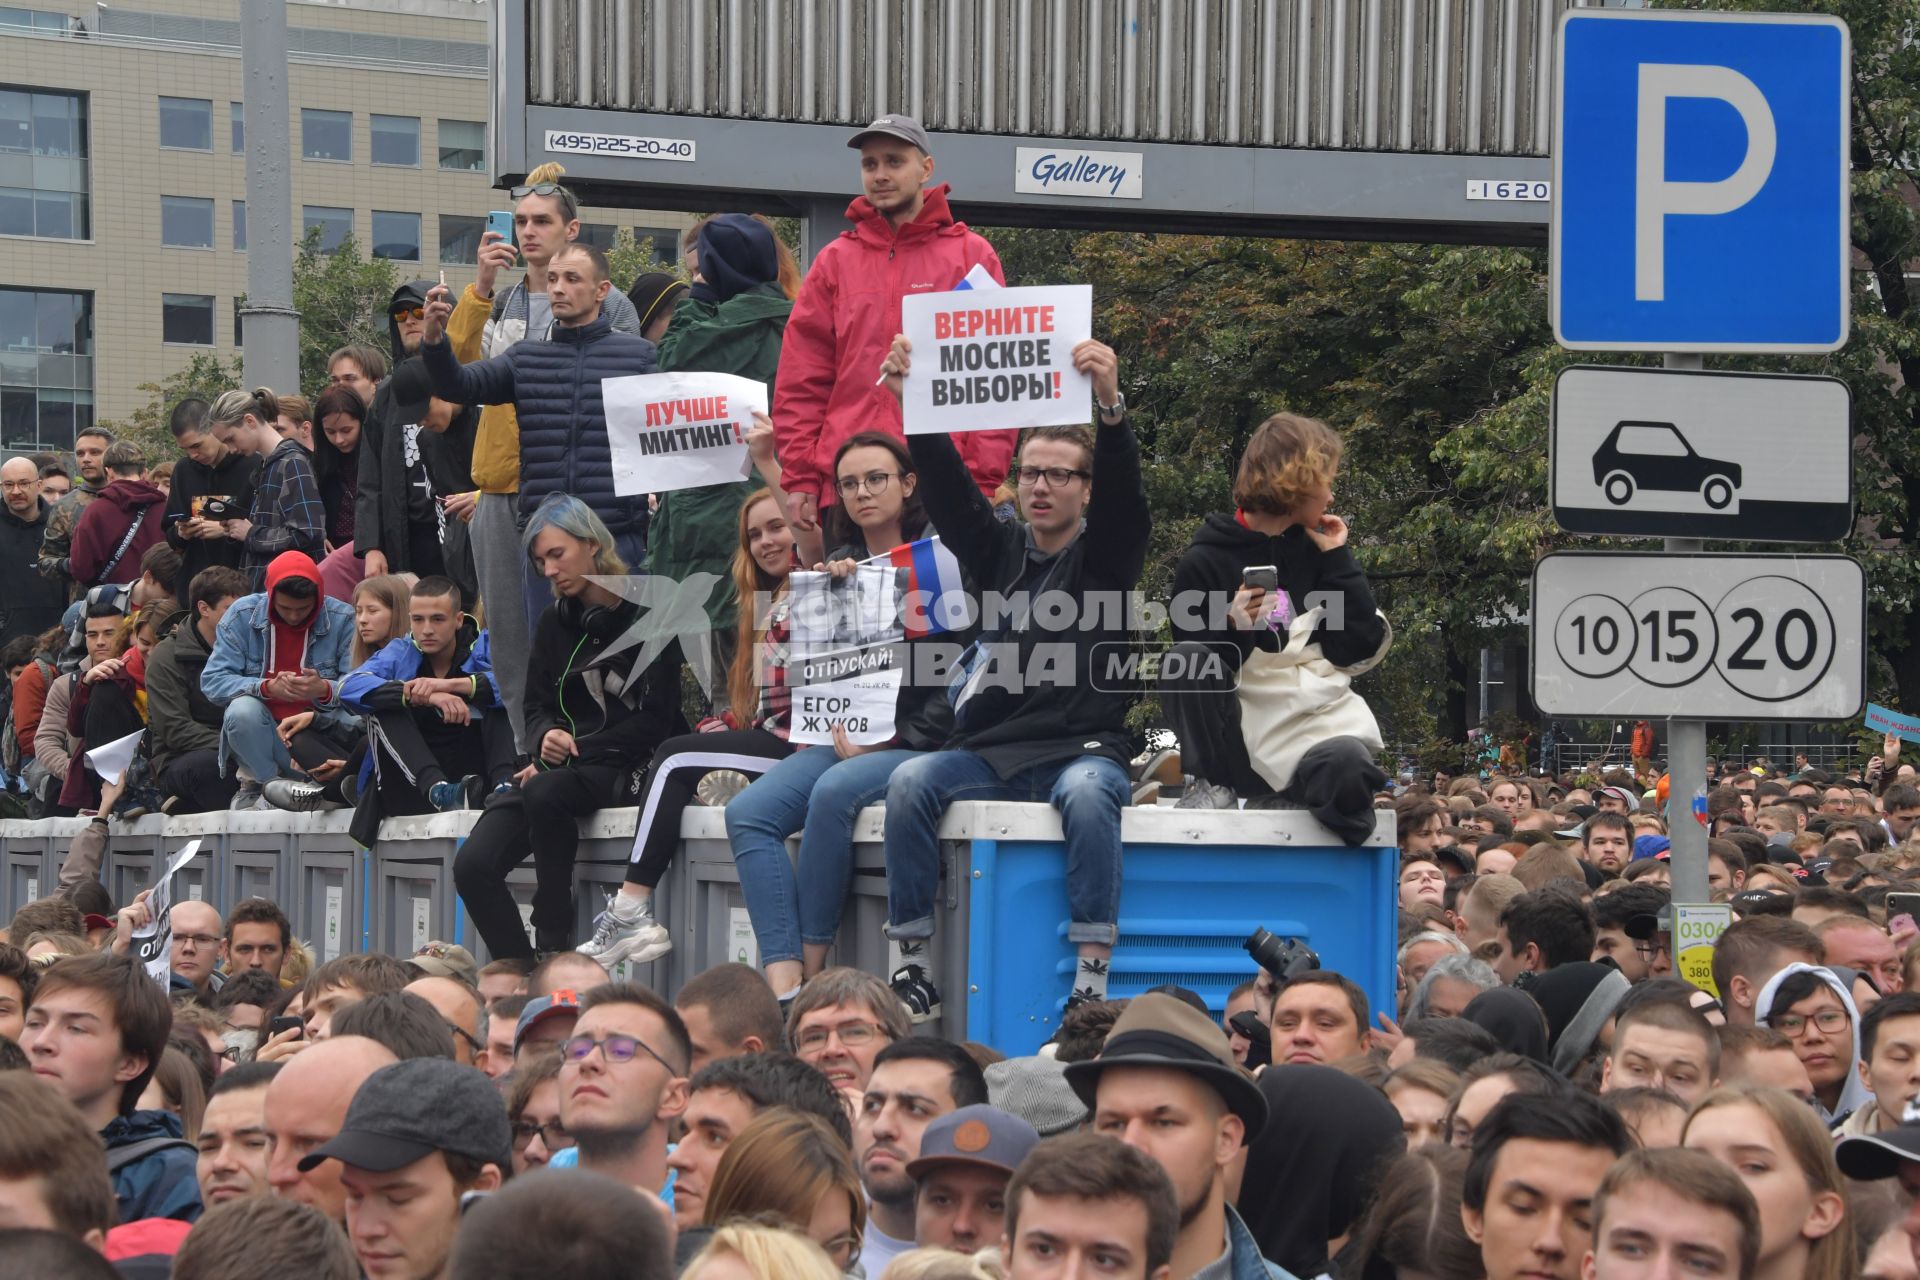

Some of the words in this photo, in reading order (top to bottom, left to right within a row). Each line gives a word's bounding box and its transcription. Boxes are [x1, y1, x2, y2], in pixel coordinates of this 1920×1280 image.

[550, 134, 691, 157] (495)225-20-40
[1032, 154, 1126, 195] Gallery
[1635, 63, 1777, 301] P
[935, 305, 1055, 340] ВЕРНИТЕ
[940, 338, 1052, 373] МОСКВЕ
[932, 371, 1062, 407] ВЫБОРЫ!
[645, 395, 729, 427] ЛУЧШЕ
[638, 422, 744, 456] МИТИНГ!
[1570, 615, 1619, 656] 10
[1641, 610, 1699, 663] 15
[1727, 607, 1818, 671] 20
[803, 647, 893, 680] ОТПУСКАЙ!
[803, 696, 851, 714] ЕГОР
[1870, 713, 1889, 726] ИВАН
[802, 716, 869, 733] ЖУКОВ
[1689, 967, 1710, 978] 380
